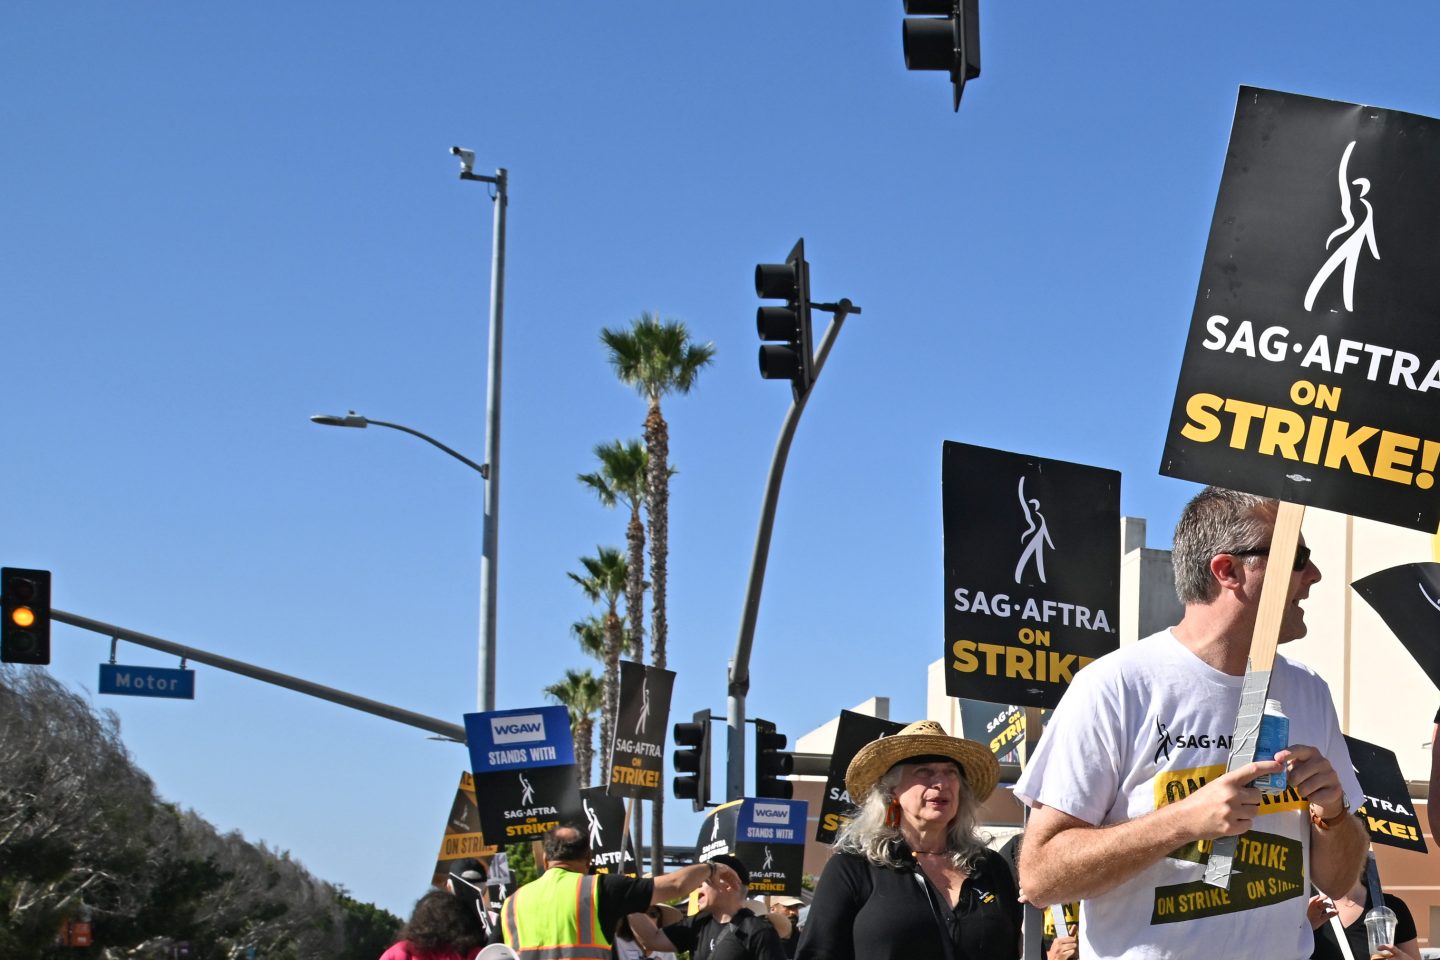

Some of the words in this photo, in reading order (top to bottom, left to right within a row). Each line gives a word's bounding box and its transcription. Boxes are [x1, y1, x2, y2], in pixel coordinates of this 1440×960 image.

[1290, 379, 1342, 412] ON
[1018, 627, 1050, 647] ON
[952, 639, 1098, 684] STRIK
[115, 672, 178, 691] Motor
[494, 722, 541, 736] WGAW
[488, 748, 528, 766] STANDS
[529, 746, 556, 762] WITH
[631, 757, 642, 767] ON
[612, 765, 660, 787] STRIKE!
[756, 808, 788, 818] WGAW
[747, 827, 773, 838] STANDS
[776, 828, 794, 839] WITH
[1236, 837, 1289, 872] TRIKE
[1157, 896, 1174, 915] ON
[1178, 888, 1231, 914] STRIKE
[1247, 879, 1265, 900] ON
